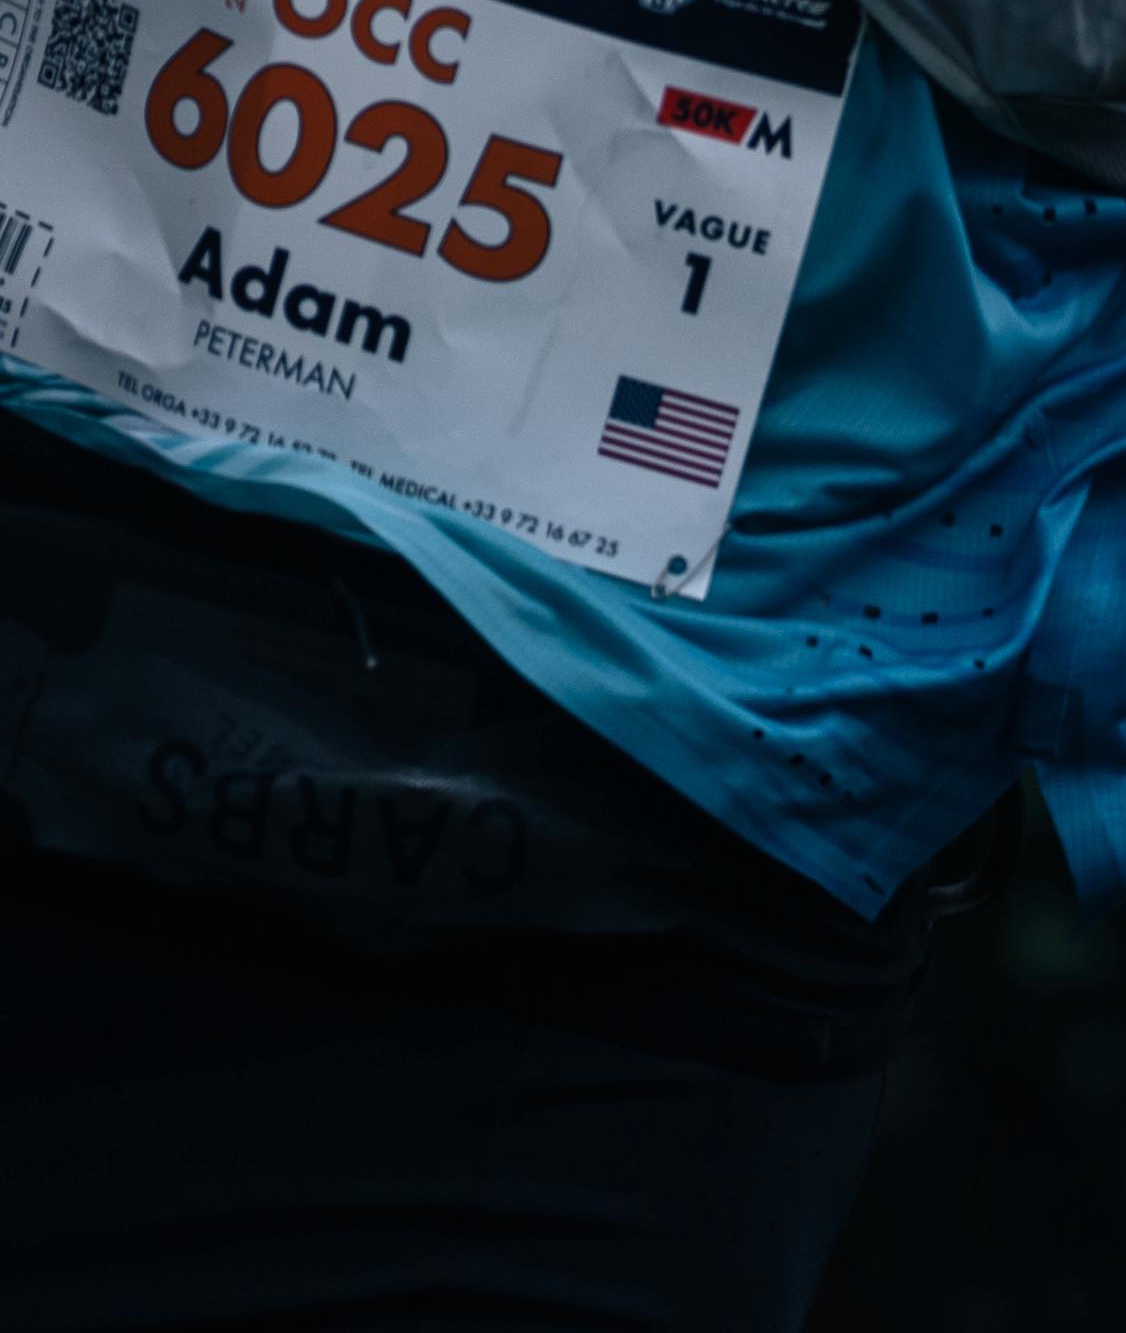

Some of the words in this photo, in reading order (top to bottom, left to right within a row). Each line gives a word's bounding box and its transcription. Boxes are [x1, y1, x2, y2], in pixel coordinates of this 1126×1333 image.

[145, 27, 563, 282] 6025
[178, 226, 412, 362] Adam
[655, 200, 771, 255] VAGUE
[682, 251, 712, 315] 1
[193, 319, 356, 400] PETERMAN
[141, 383, 186, 417] ORGA
[191, 407, 220, 430] +33
[463, 499, 496, 522] +33
[136, 740, 528, 892] CARBS
